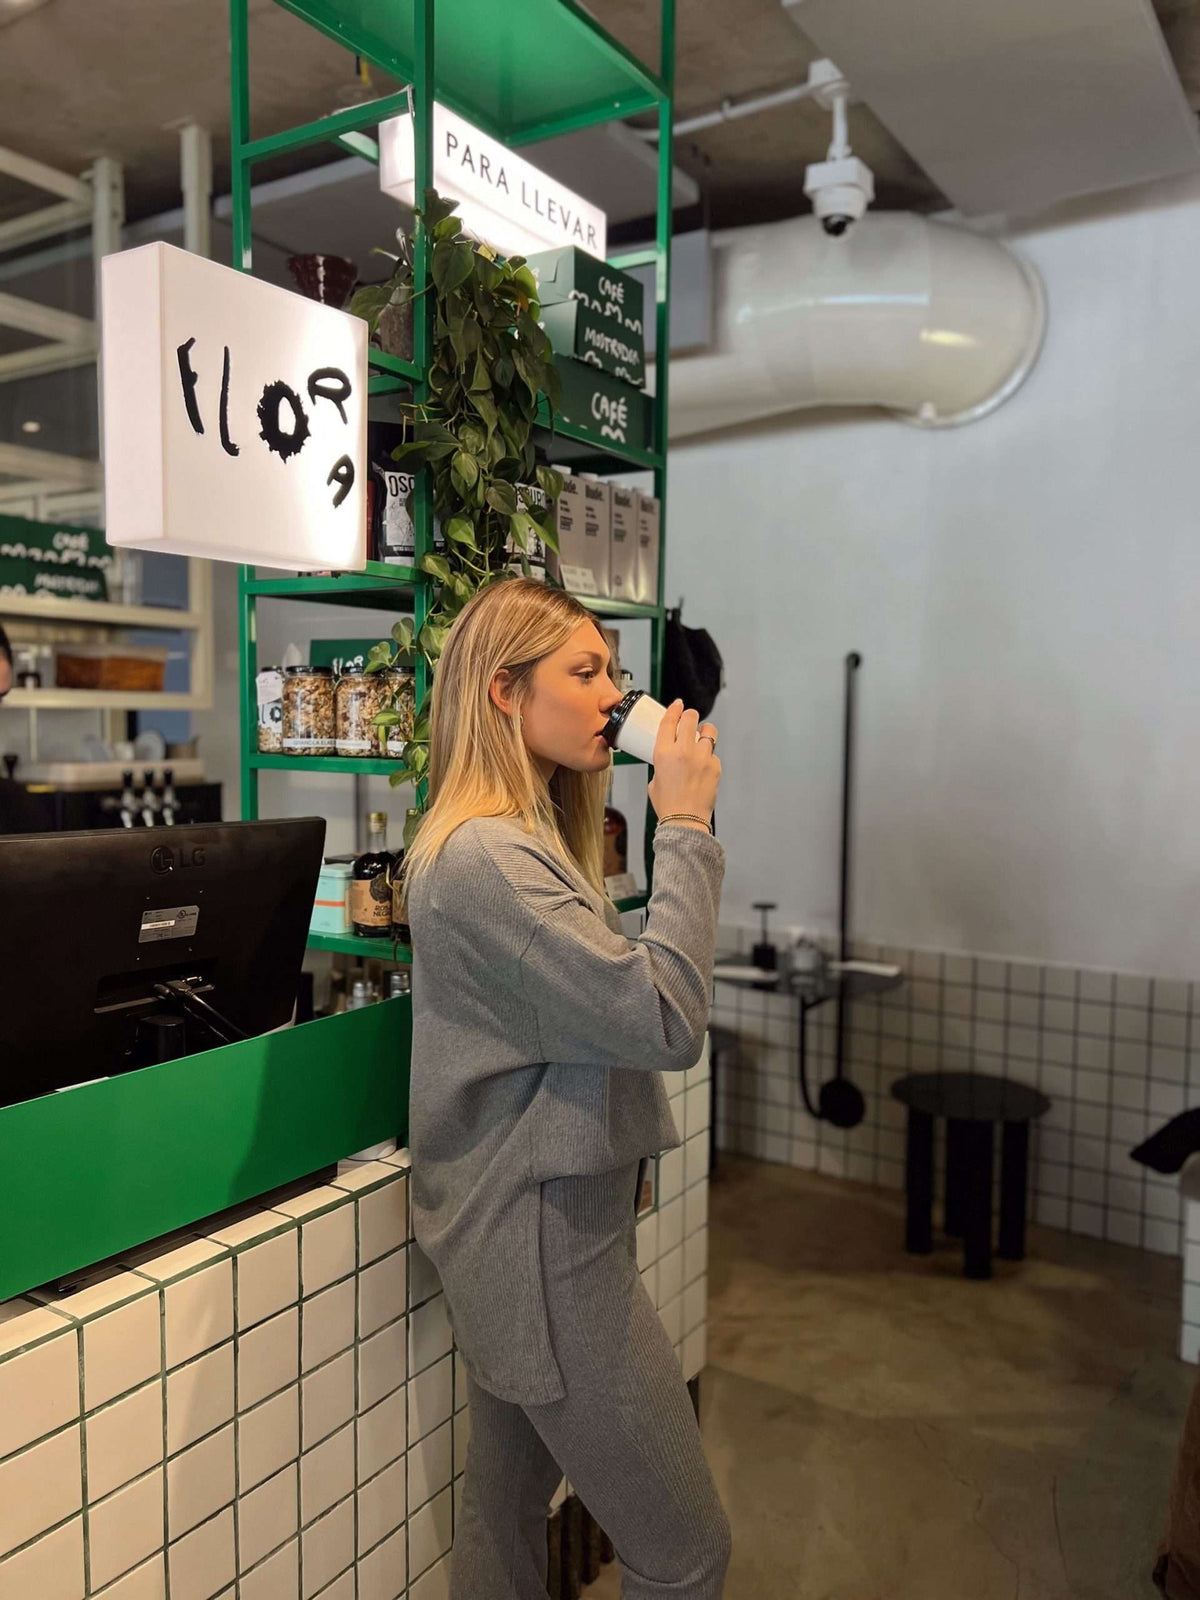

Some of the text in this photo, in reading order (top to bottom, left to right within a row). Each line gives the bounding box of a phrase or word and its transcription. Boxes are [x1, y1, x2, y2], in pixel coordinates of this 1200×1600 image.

[446, 130, 598, 250] PARA LLEVAR
[598, 276, 625, 304] CAFÉ
[591, 392, 628, 429] CAFÉ
[180, 848, 206, 870] LG
